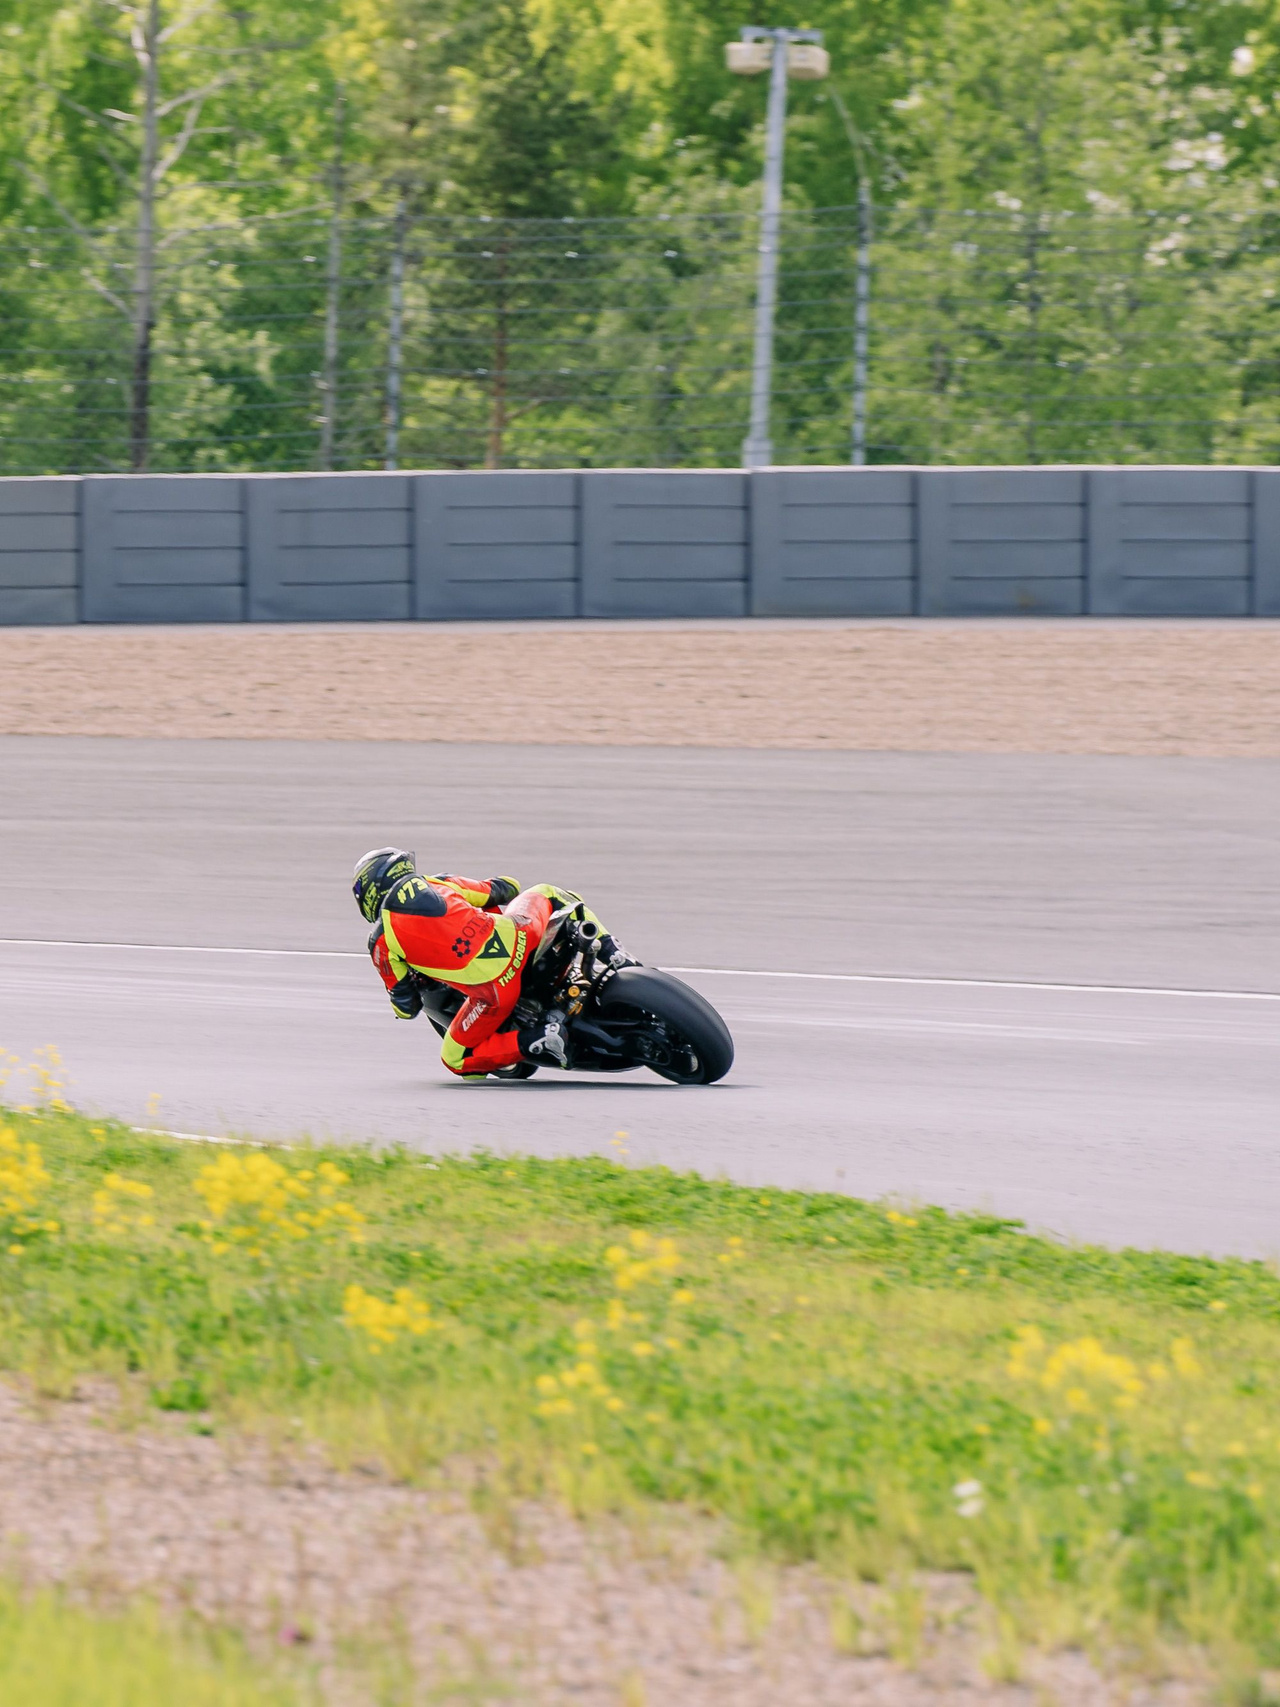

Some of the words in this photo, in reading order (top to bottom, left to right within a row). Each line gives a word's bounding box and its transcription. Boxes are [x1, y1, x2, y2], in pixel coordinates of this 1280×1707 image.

[397, 878, 428, 904] #73
[498, 966, 516, 987] THE
[512, 930, 527, 969] BOBER
